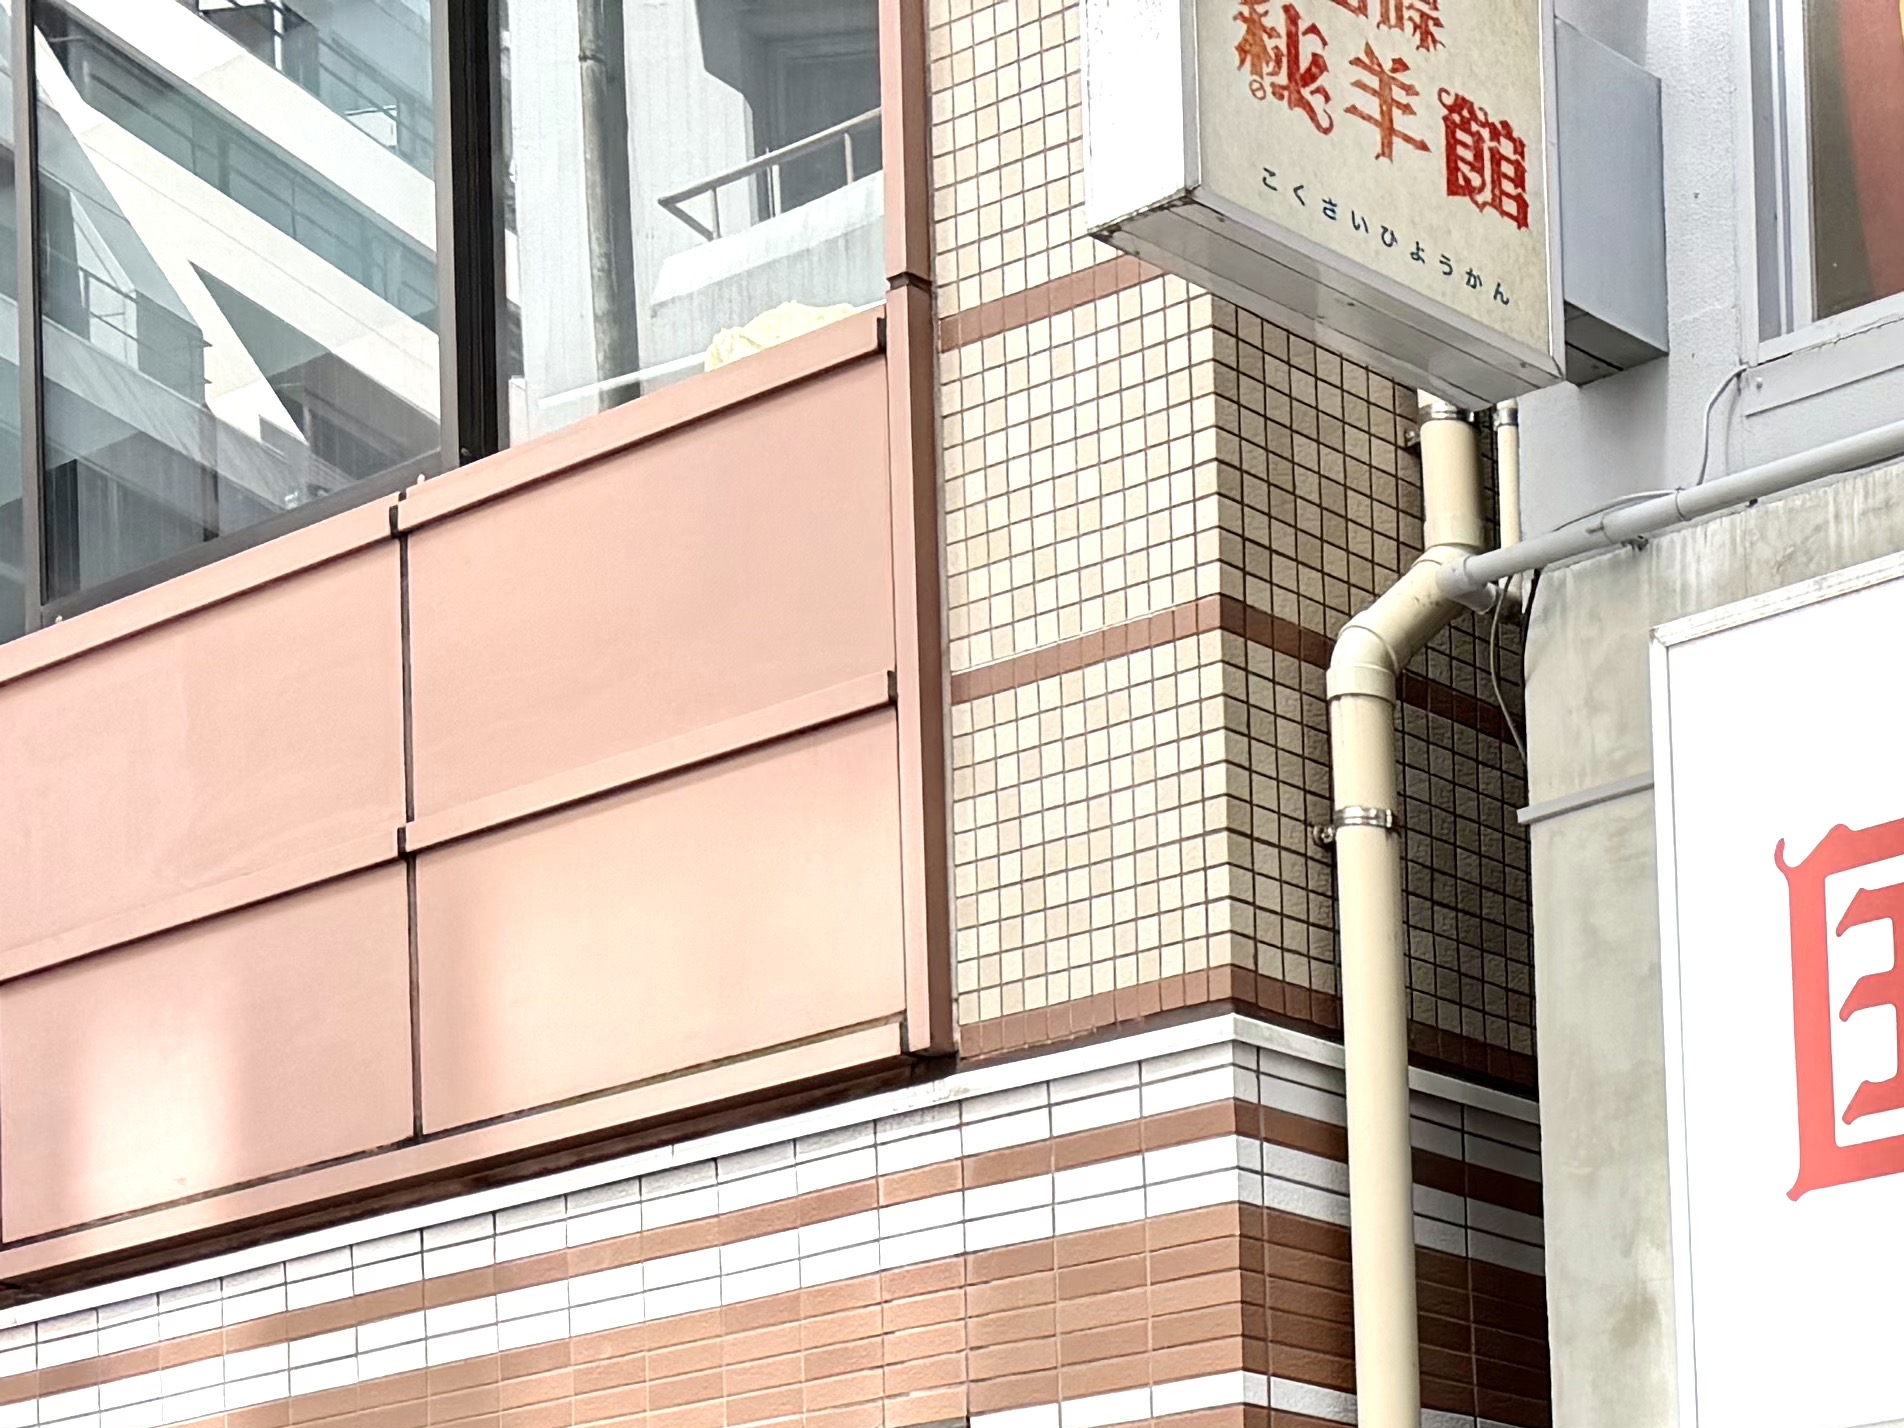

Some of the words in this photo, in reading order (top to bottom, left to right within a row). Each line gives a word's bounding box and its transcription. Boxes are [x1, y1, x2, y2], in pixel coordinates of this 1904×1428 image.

[1262, 167, 1510, 306] こくさいひようかん
